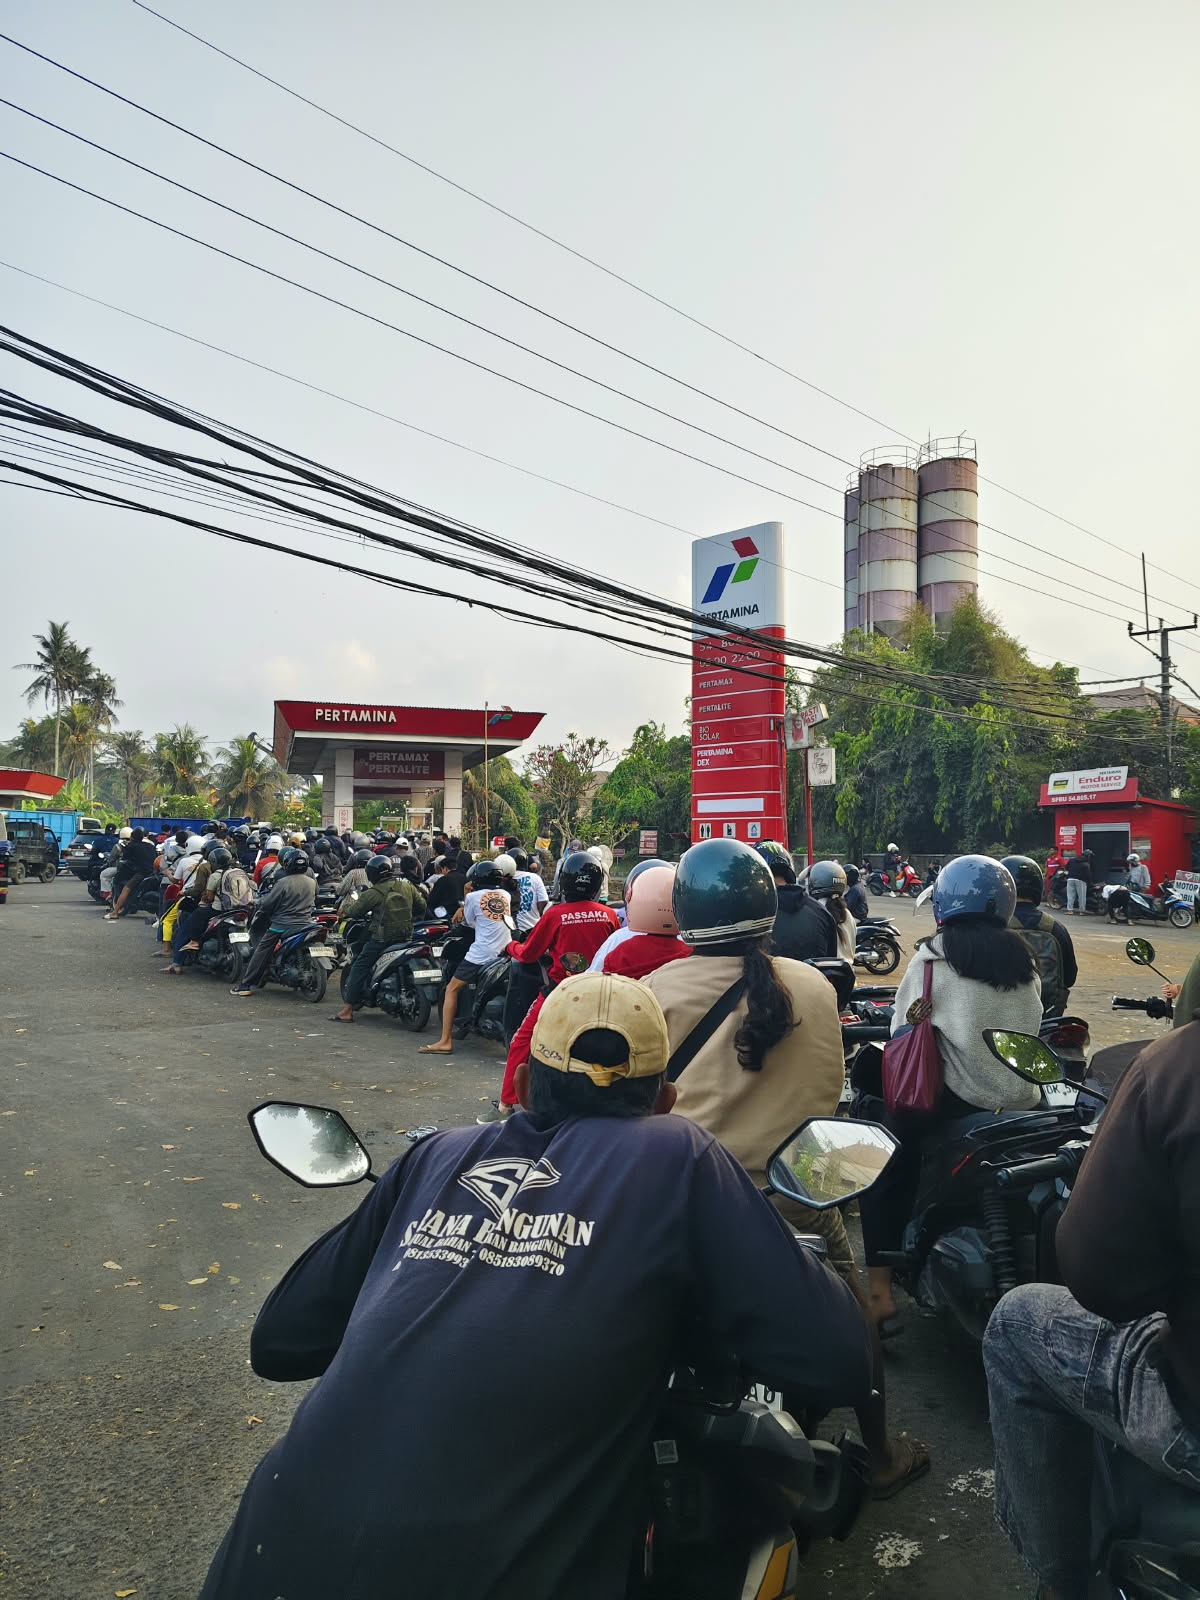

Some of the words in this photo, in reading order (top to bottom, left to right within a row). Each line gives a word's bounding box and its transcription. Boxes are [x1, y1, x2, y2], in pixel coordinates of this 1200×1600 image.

[699, 677, 734, 688] PERTAMAX
[698, 702, 732, 713] PERTALITE
[315, 708, 397, 723] PERTAMINA
[699, 732, 720, 741] SOLAR
[368, 752, 429, 762] PERTAMAX
[696, 747, 734, 757] PERTAMINA
[696, 758, 710, 767] DEX
[368, 764, 430, 775] PERTALITE
[1078, 775, 1122, 785] Enduro
[560, 911, 609, 922] PASSAKA
[508, 1239, 567, 1260] BANGUNAN
